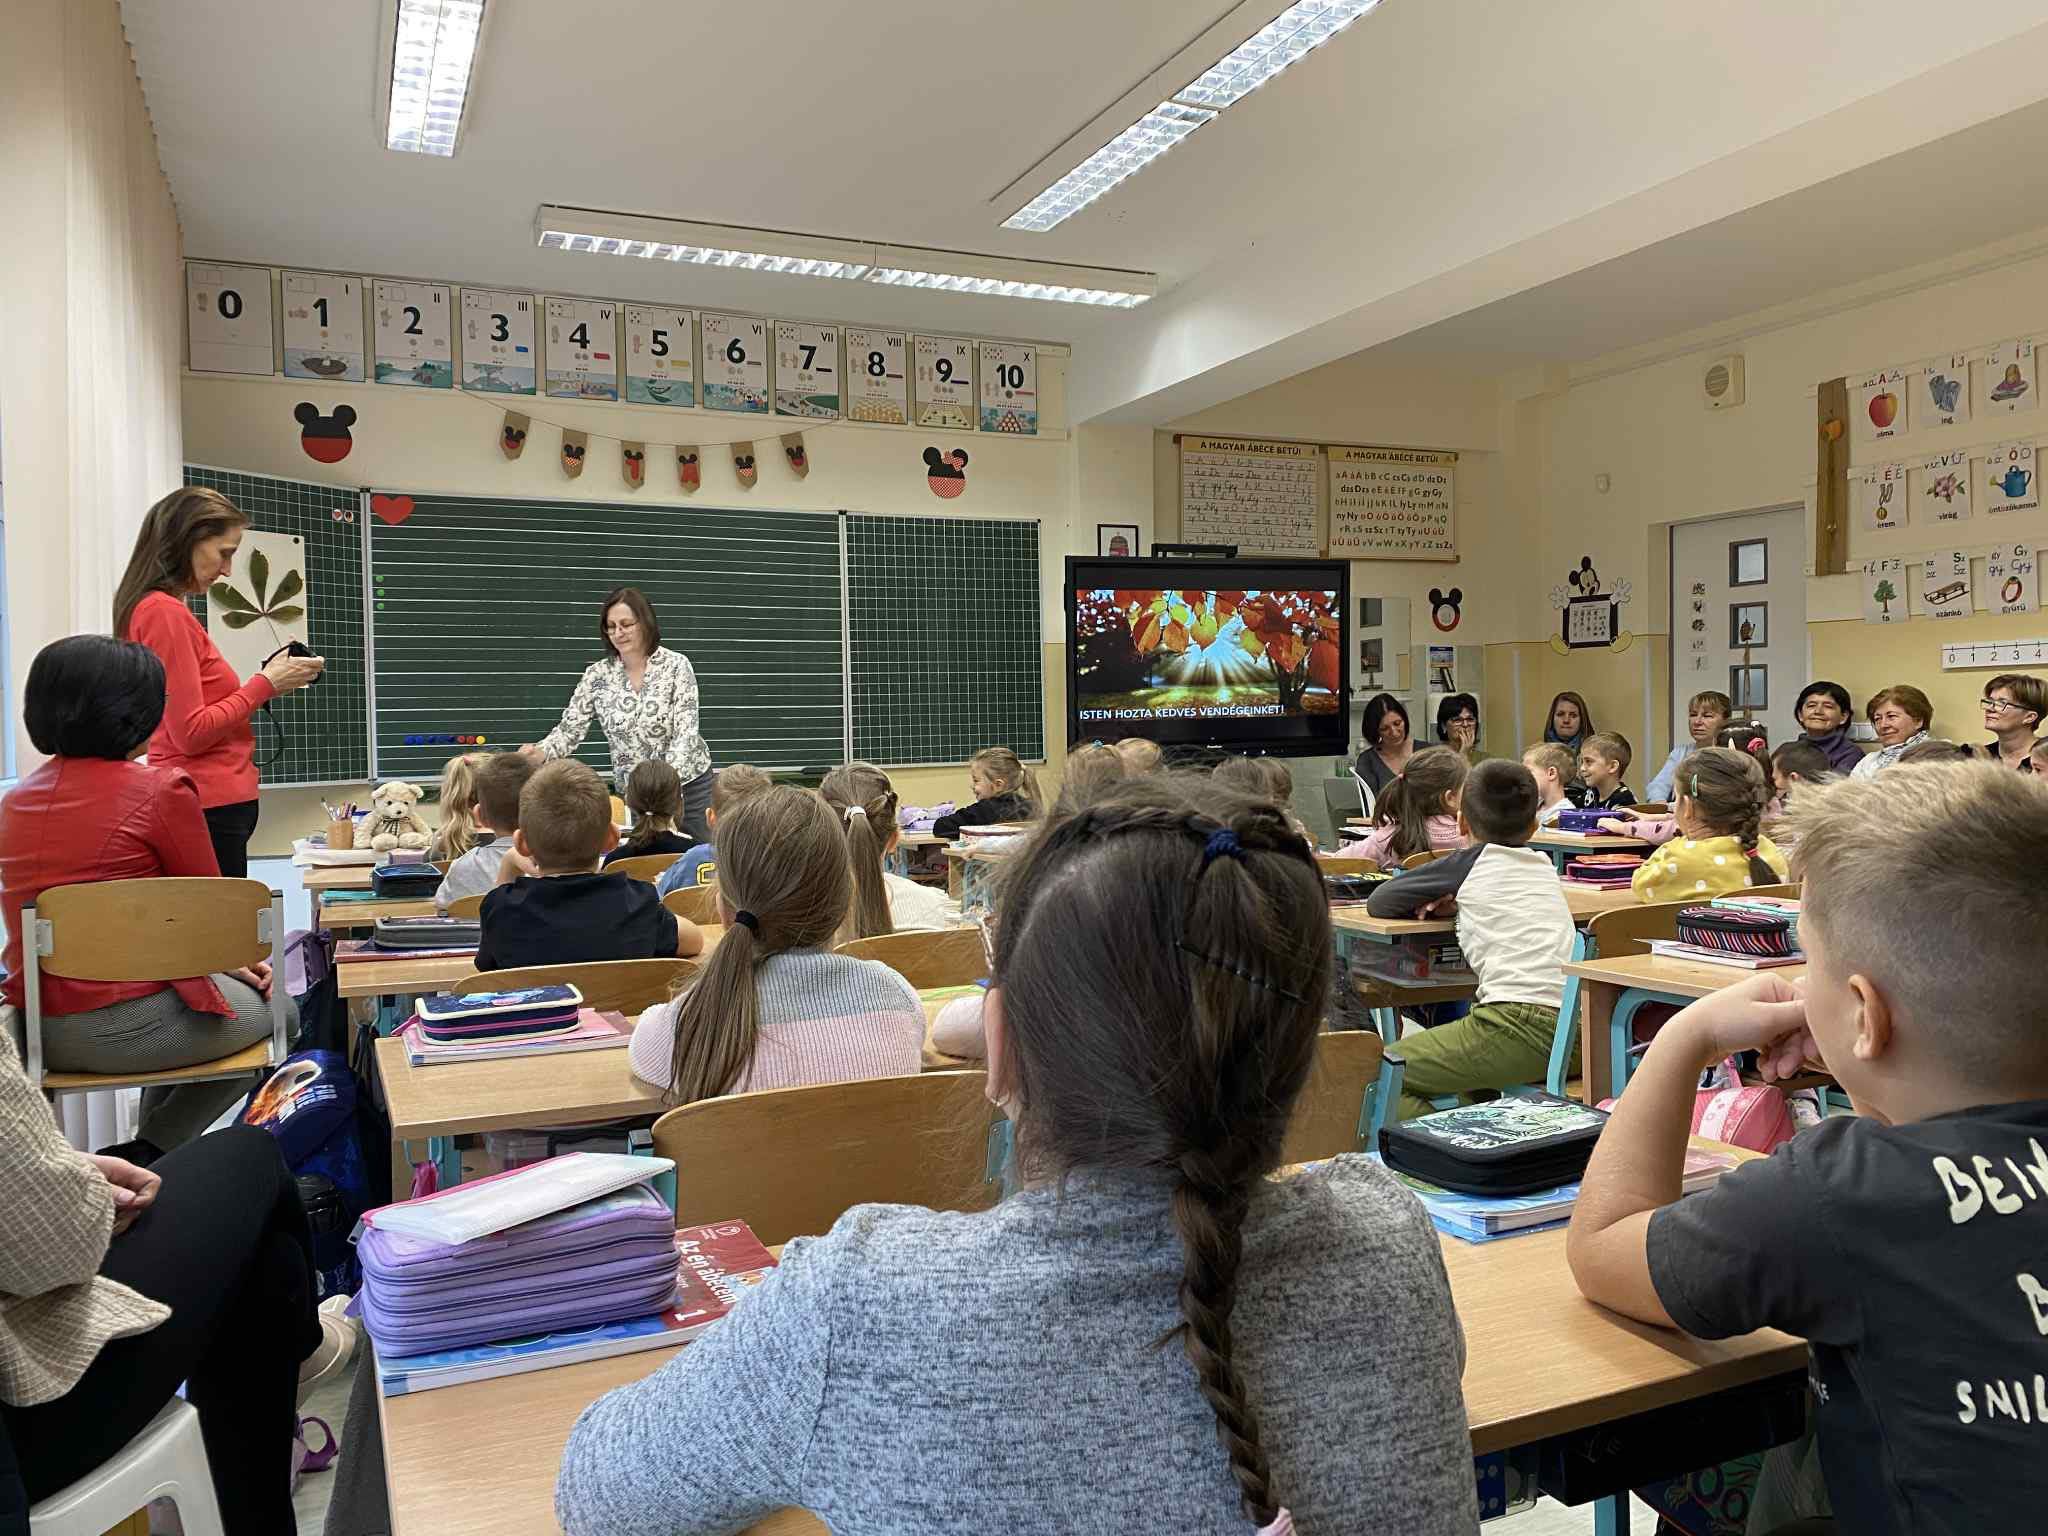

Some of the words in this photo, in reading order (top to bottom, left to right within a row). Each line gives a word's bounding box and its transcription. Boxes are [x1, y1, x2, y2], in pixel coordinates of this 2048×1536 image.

[217, 289, 243, 320] 0
[433, 292, 441, 303] II
[312, 298, 328, 328] 1
[517, 301, 528, 312] III
[403, 306, 424, 335] 2
[600, 309, 612, 321] IV
[677, 316, 685, 328] V
[490, 313, 510, 342] 3
[751, 324, 762, 336] VI
[568, 323, 591, 350] 4
[650, 330, 669, 357] 5
[820, 332, 834, 343] VII
[886, 337, 902, 347] VIII
[726, 337, 746, 364] 6
[799, 345, 817, 371] 7
[956, 345, 966, 356] IX
[1023, 352, 1031, 362] X
[867, 351, 886, 377] 8
[935, 358, 953, 383] 9
[995, 363, 1025, 390] 10
[1209, 442, 1245, 451] MAGYAR
[1354, 452, 1387, 460] MAGYAR
[1949, 653, 1956, 663] 0
[1991, 651, 1998, 661] 2
[2012, 649, 2020, 661] 3
[2034, 648, 2042, 658] 4
[1079, 709, 1112, 720] ISTEN
[1114, 708, 1151, 719] HOZTA
[1155, 706, 1197, 718] KEDVES
[1199, 704, 1285, 717] VENDÉGEINKET!
[677, 1240, 701, 1255] Az
[686, 1254, 715, 1269] én
[674, 1309, 707, 1321] 1
